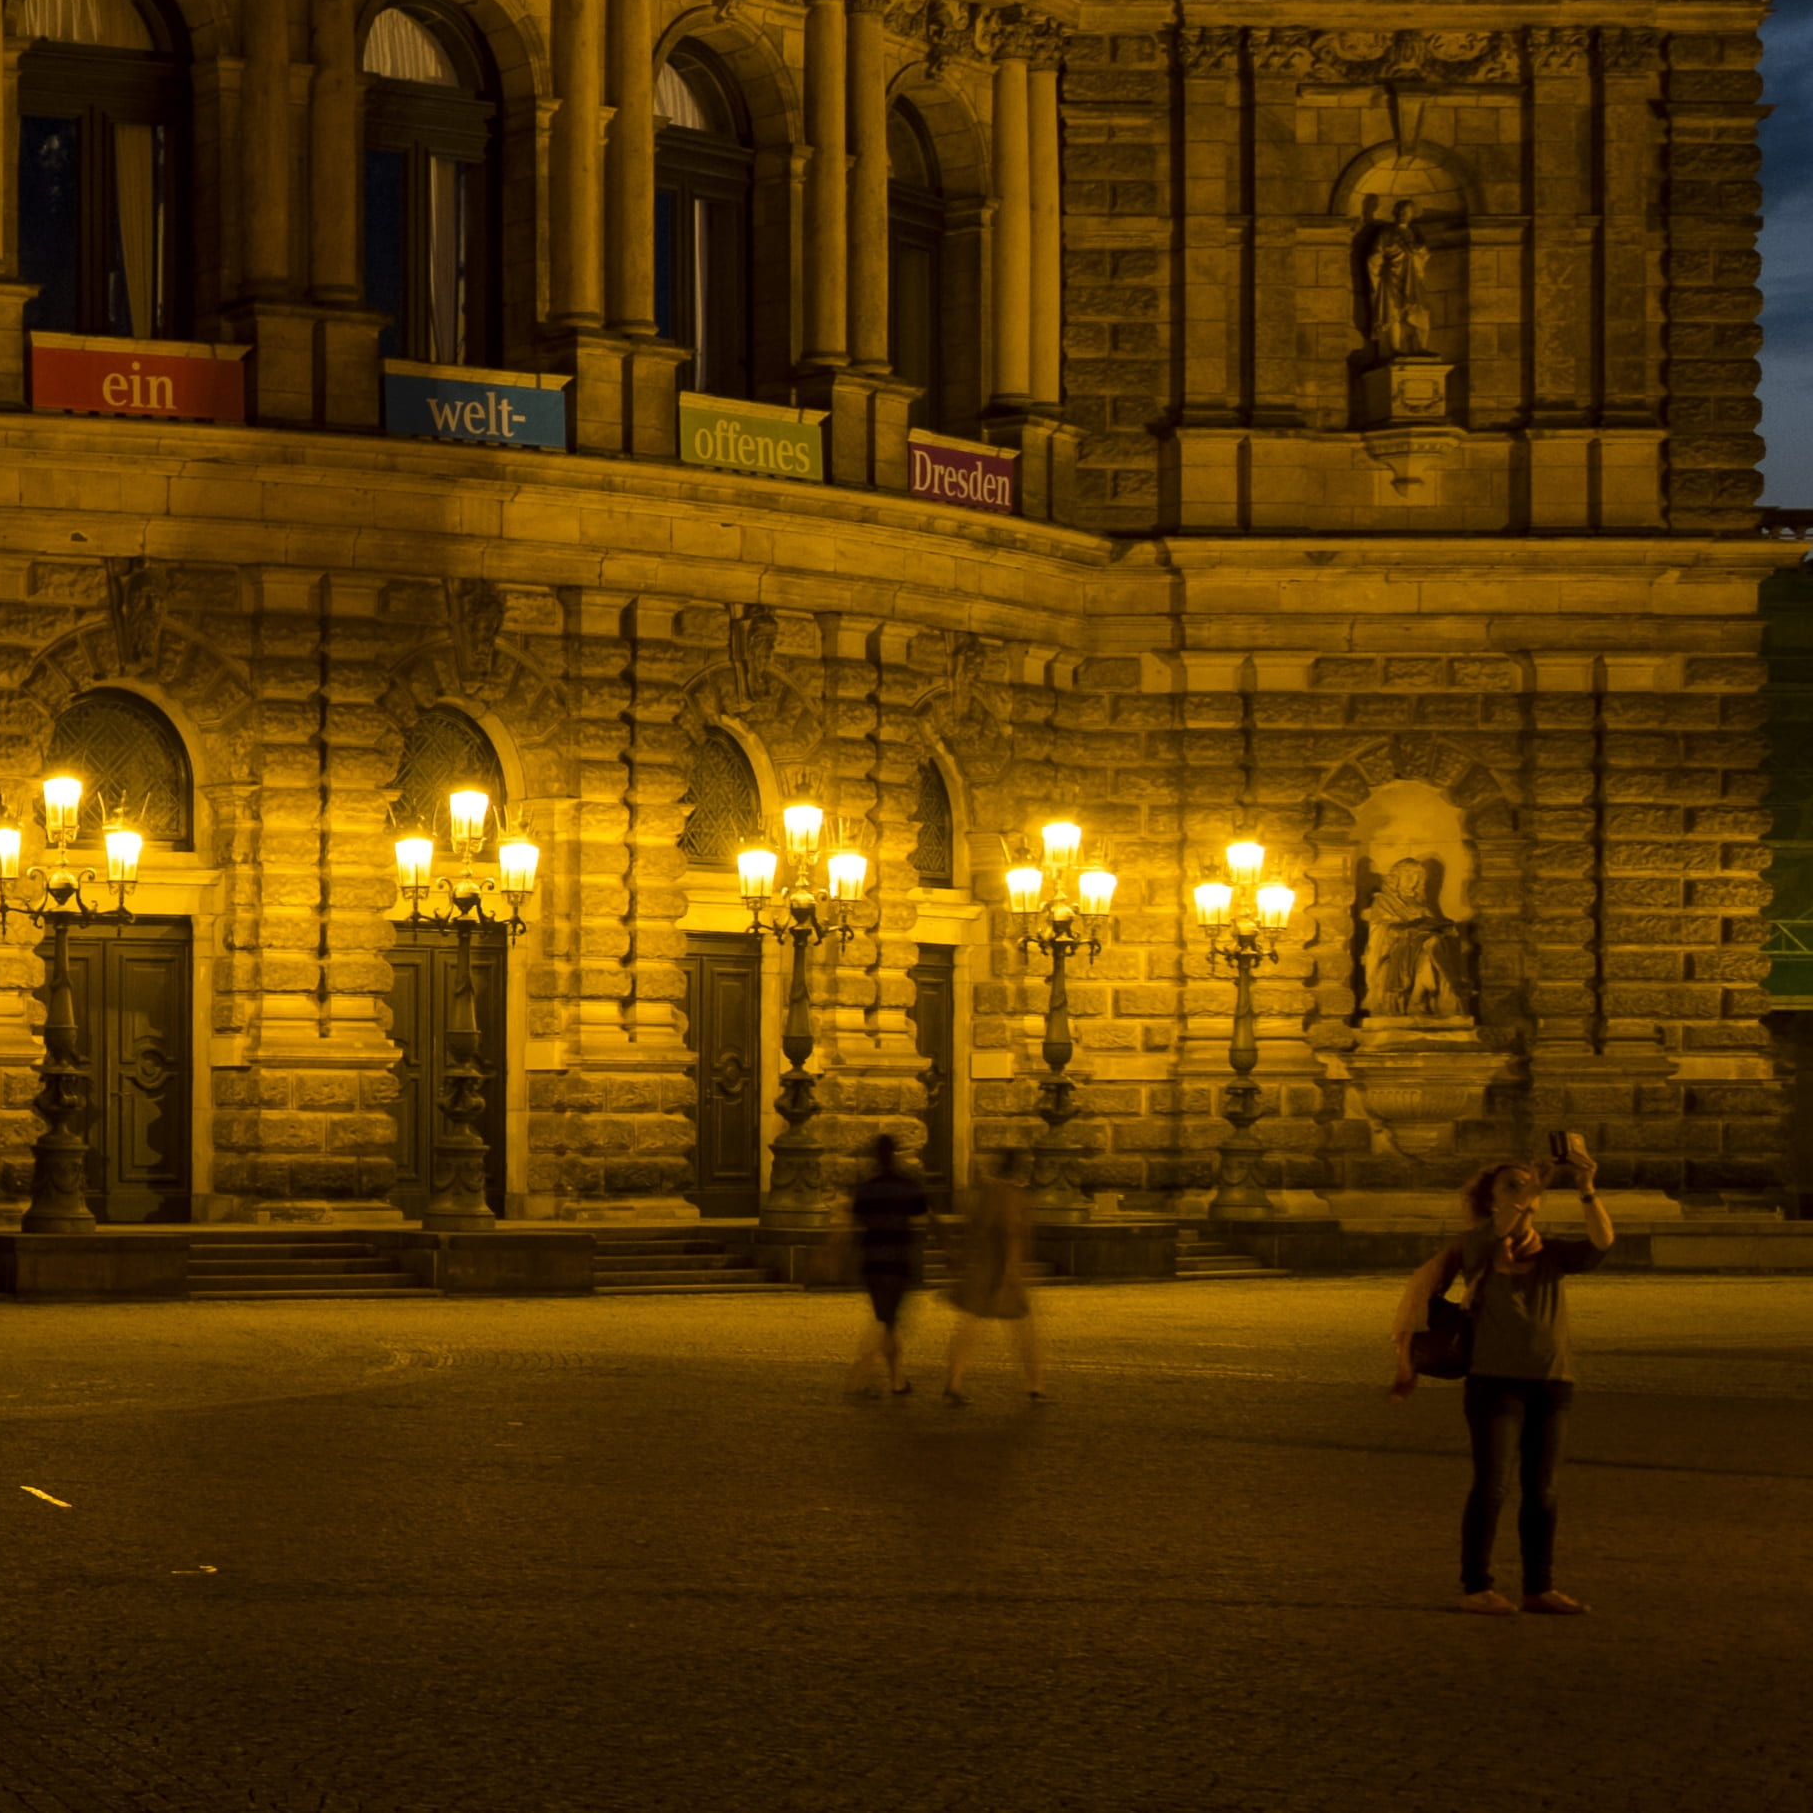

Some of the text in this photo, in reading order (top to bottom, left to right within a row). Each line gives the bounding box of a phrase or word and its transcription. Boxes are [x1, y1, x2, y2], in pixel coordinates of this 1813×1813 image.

[102, 360, 177, 411] ein
[426, 391, 527, 438] welt-
[694, 419, 811, 474] offenes
[913, 449, 1011, 506] Dresden
